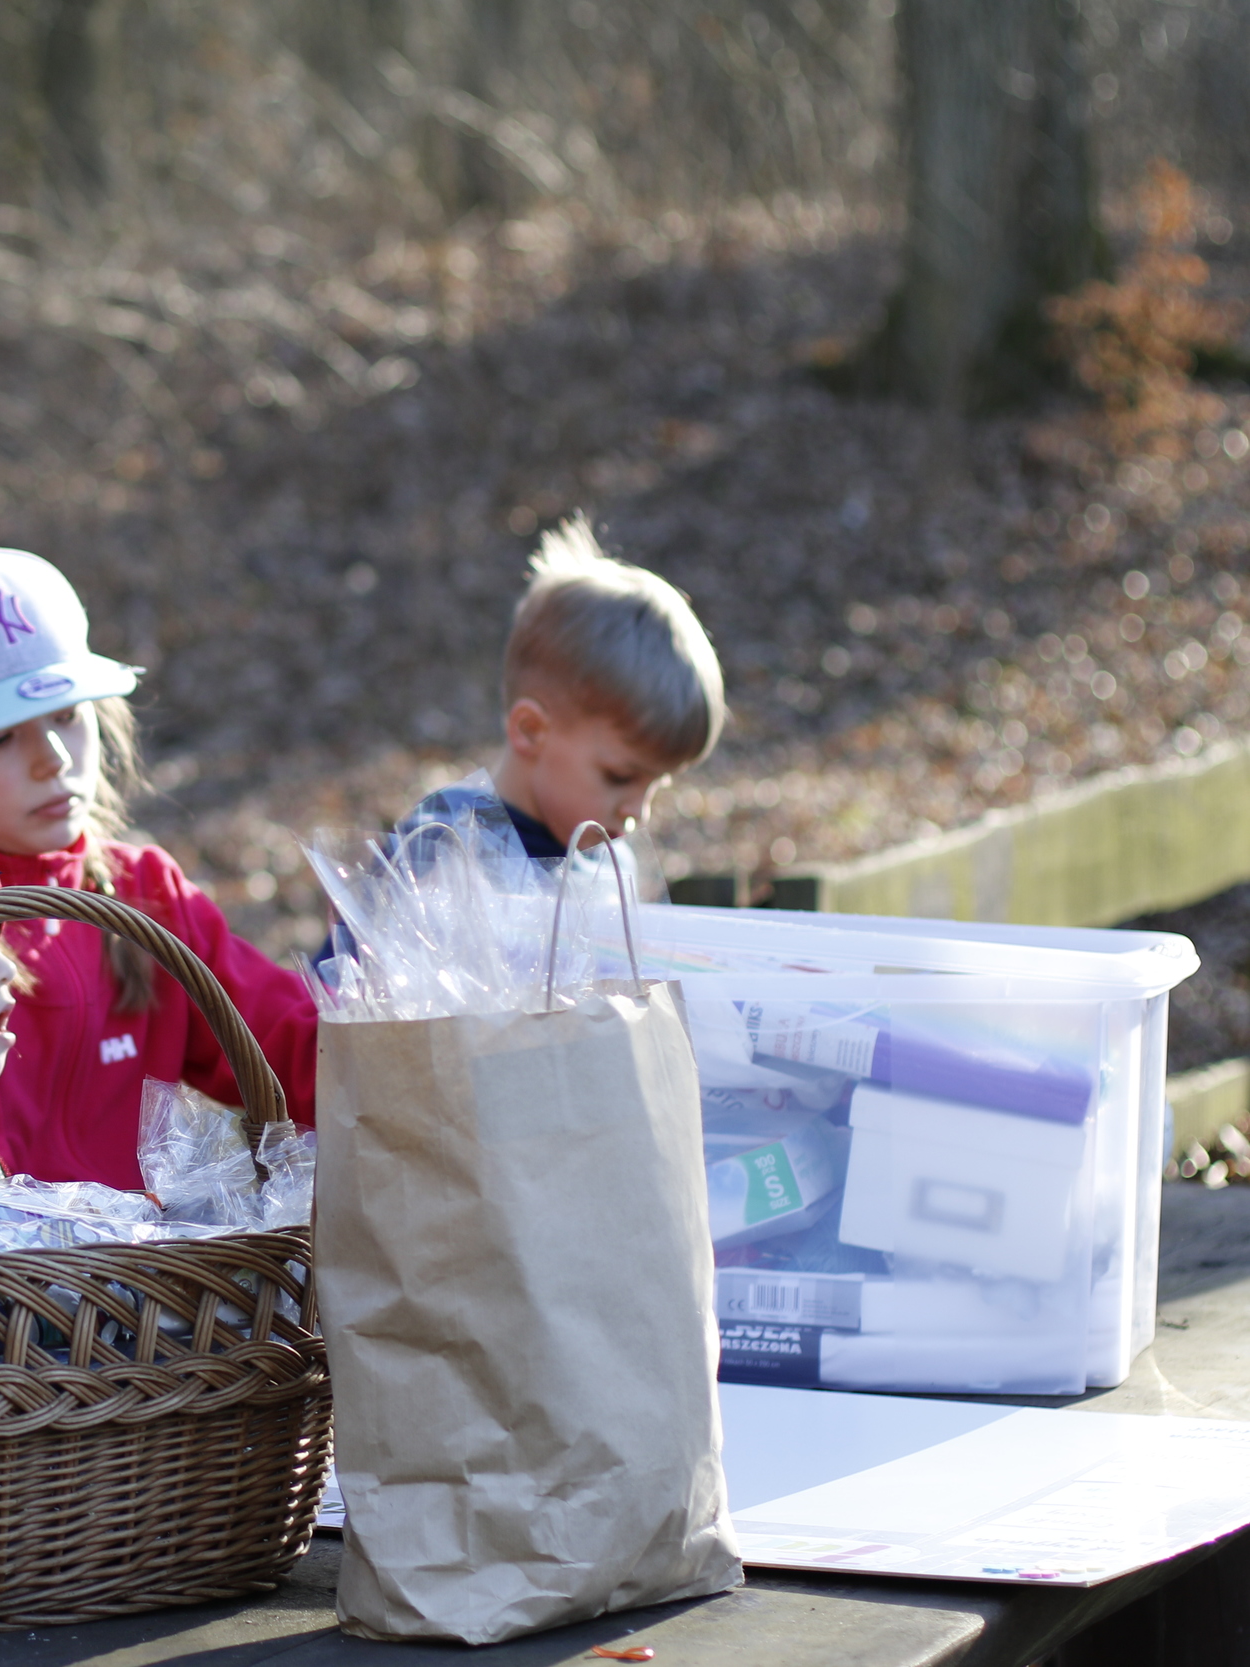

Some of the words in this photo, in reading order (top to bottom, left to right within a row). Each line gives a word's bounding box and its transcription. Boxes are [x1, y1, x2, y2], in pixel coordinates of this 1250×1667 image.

[99, 1033, 138, 1064] HH
[754, 1154, 776, 1169] 100
[764, 1175, 785, 1198] S
[769, 1196, 791, 1210] SIZE
[721, 1338, 802, 1354] RSZCZONA
